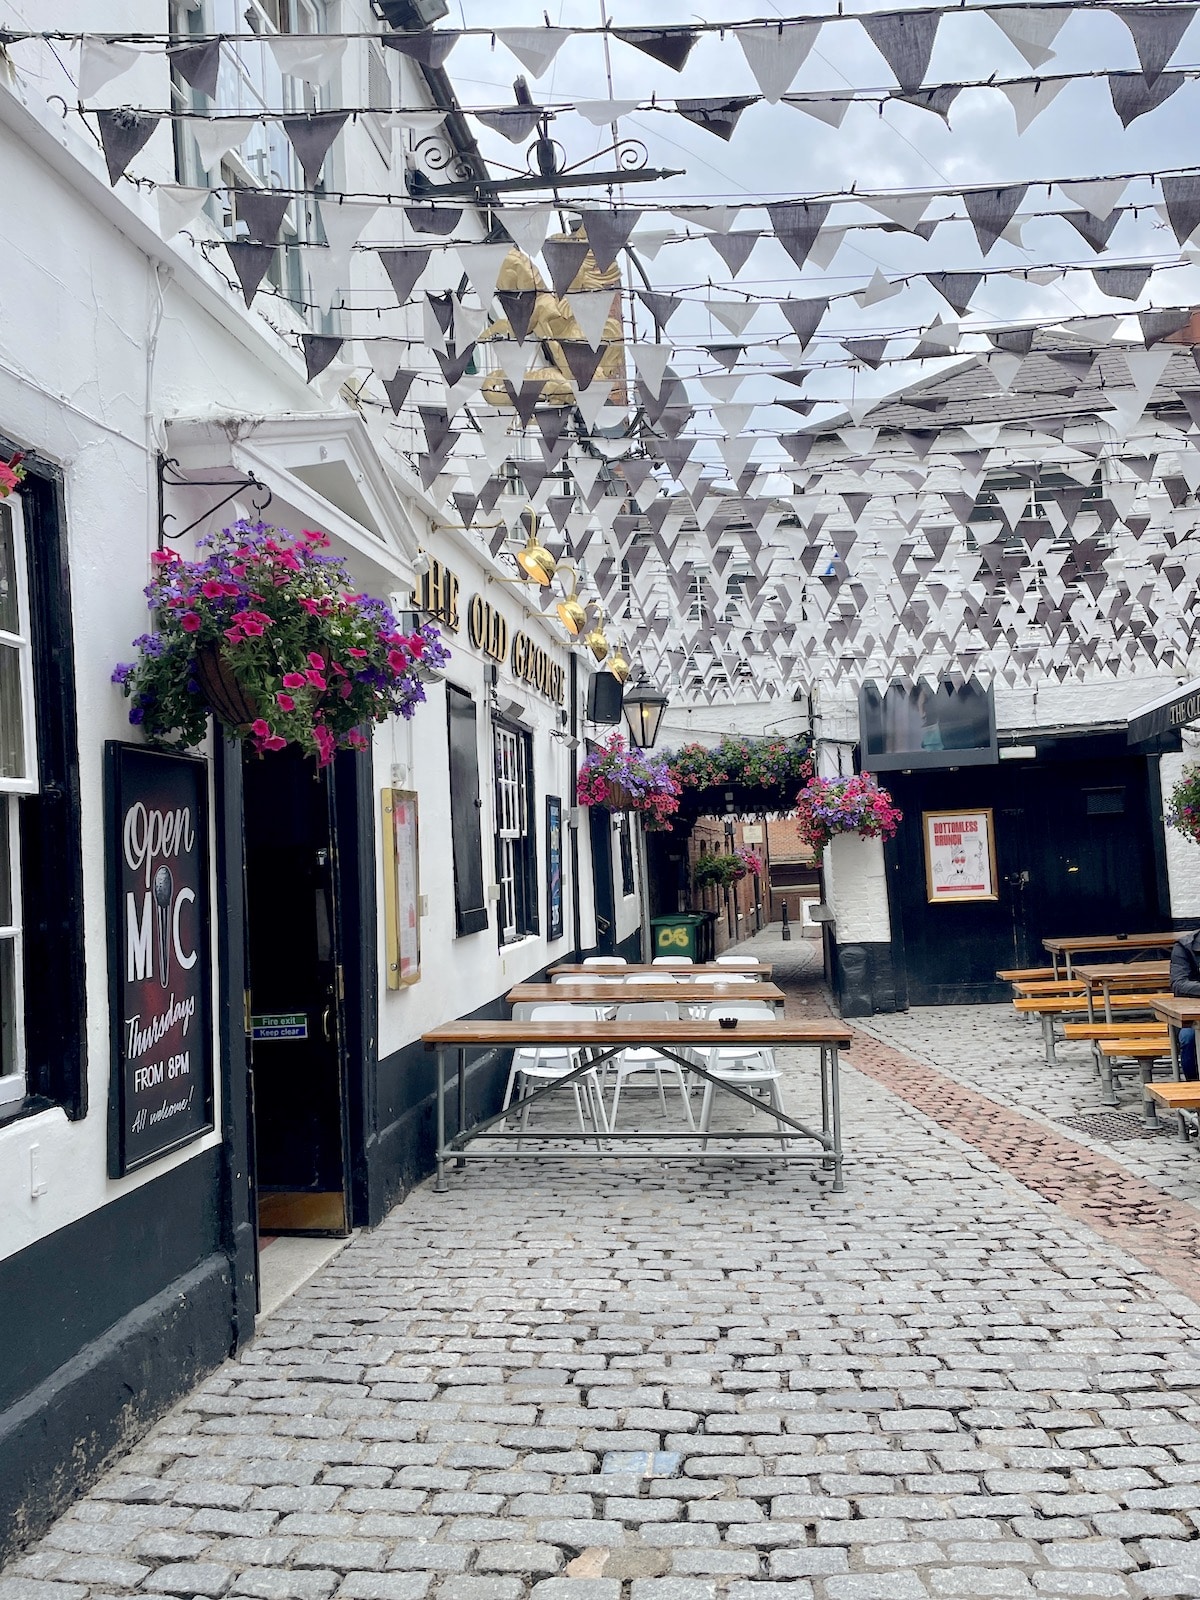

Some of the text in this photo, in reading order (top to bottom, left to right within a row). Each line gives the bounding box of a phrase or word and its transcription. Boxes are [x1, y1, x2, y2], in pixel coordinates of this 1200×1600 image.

[410, 547, 565, 706] THE OLD GEORGE
[1170, 701, 1186, 725] THE
[933, 820, 979, 834] BOTTOMLESS
[934, 834, 962, 847] BRUNCH
[124, 801, 195, 889] Open
[125, 992, 195, 1060] Thursdays
[260, 1027, 300, 1037] Keep clear
[262, 1016, 296, 1026] Fire exit
[134, 1051, 190, 1093] FROM 8PM
[131, 1085, 195, 1134] All welcome!
